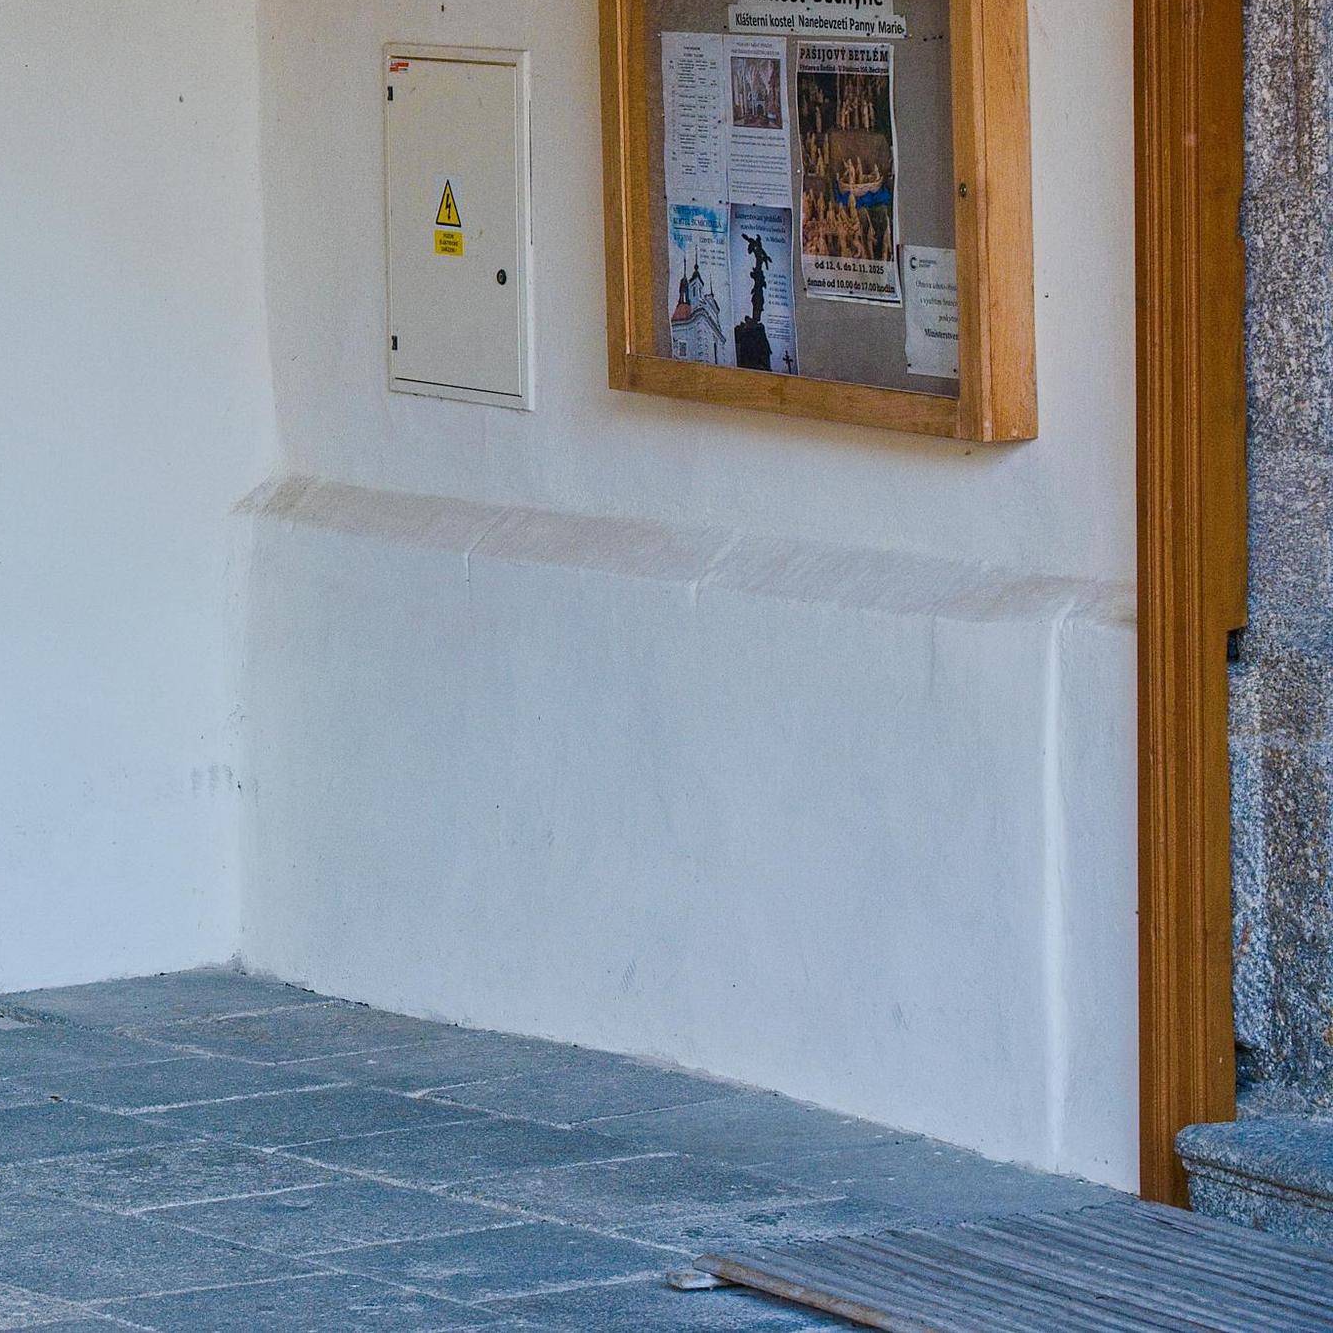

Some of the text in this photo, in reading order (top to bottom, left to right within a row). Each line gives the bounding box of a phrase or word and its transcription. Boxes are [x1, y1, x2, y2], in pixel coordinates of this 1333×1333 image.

[769, 13, 795, 28] kostel
[849, 19, 876, 35] Panny
[878, 20, 903, 35] Marie
[799, 45, 846, 62] PAŠIJOVÝ
[848, 47, 889, 62] BETLÉM
[814, 261, 824, 270] od
[844, 262, 852, 271] do
[869, 265, 885, 275] 2025
[826, 278, 836, 288] od
